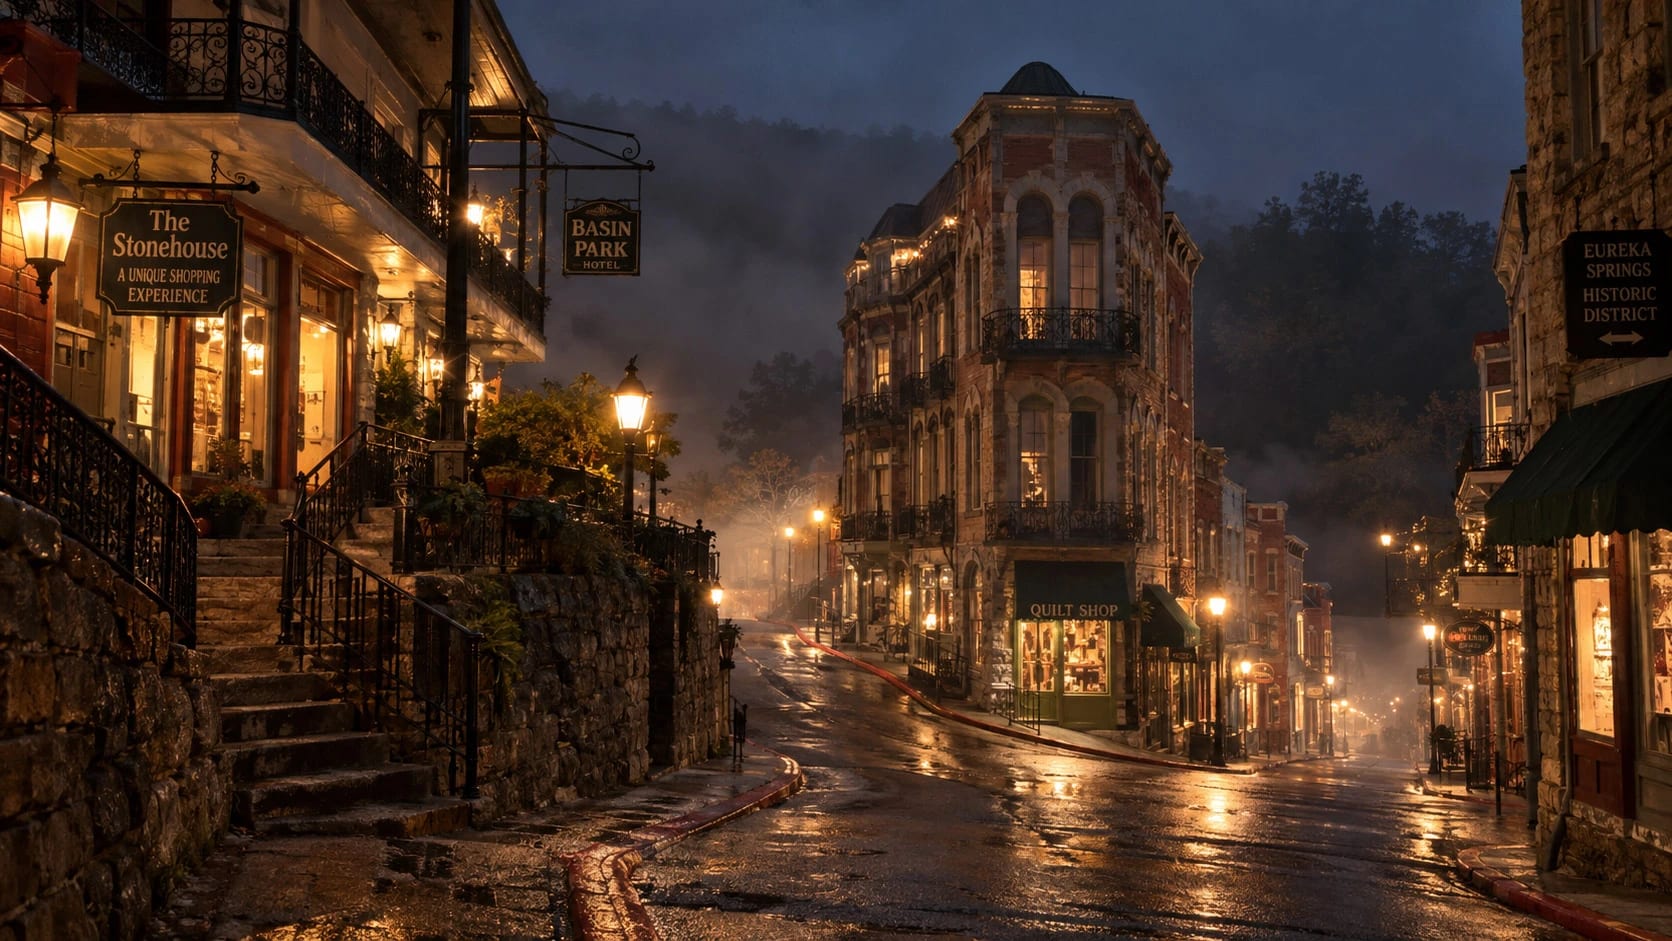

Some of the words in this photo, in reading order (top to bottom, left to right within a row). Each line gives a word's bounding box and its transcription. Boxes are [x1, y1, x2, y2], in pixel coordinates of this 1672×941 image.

[149, 209, 190, 232] The
[571, 218, 632, 237] BASIN
[112, 232, 228, 259] Stonehouse
[574, 240, 629, 257] PARK
[1583, 241, 1652, 258] EUREKA
[583, 260, 620, 269] HOTEL
[1586, 262, 1652, 278] SPRINGS
[117, 267, 126, 282] A
[129, 267, 167, 285] UNIQUE
[169, 268, 220, 284] SHOPPING
[128, 287, 208, 304] EXPERIENCE
[1583, 286, 1657, 302] HISTORIC
[1583, 306, 1657, 322] DISTRICT
[1030, 603, 1074, 618] QUILT
[1079, 604, 1118, 617] SHOP
